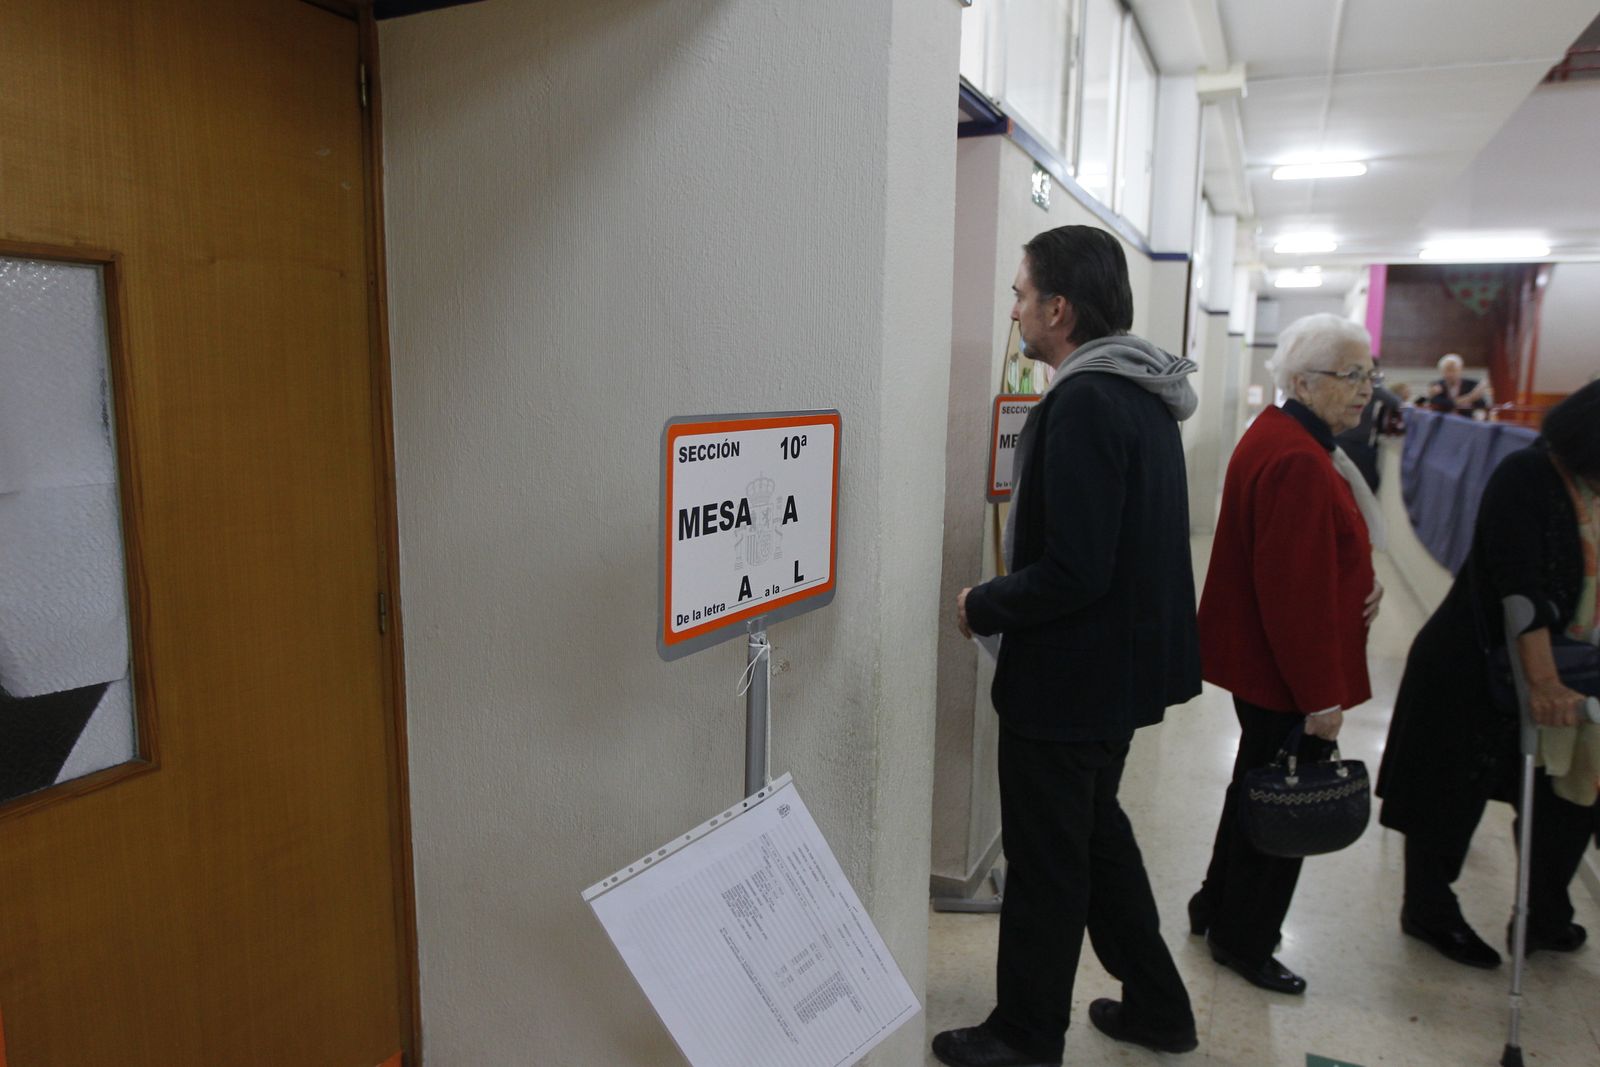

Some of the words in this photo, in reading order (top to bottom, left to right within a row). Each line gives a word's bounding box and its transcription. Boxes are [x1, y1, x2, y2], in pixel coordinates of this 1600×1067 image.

[678, 439, 740, 463] SECCIÓN
[1000, 434, 1018, 449] ME
[678, 498, 752, 541] MESA
[782, 495, 798, 525] A
[676, 614, 690, 626] De
[692, 609, 701, 621] la
[704, 603, 726, 617] letra
[738, 575, 752, 602] A
[764, 588, 771, 598] a
[772, 584, 780, 595] la
[794, 560, 804, 583] L
